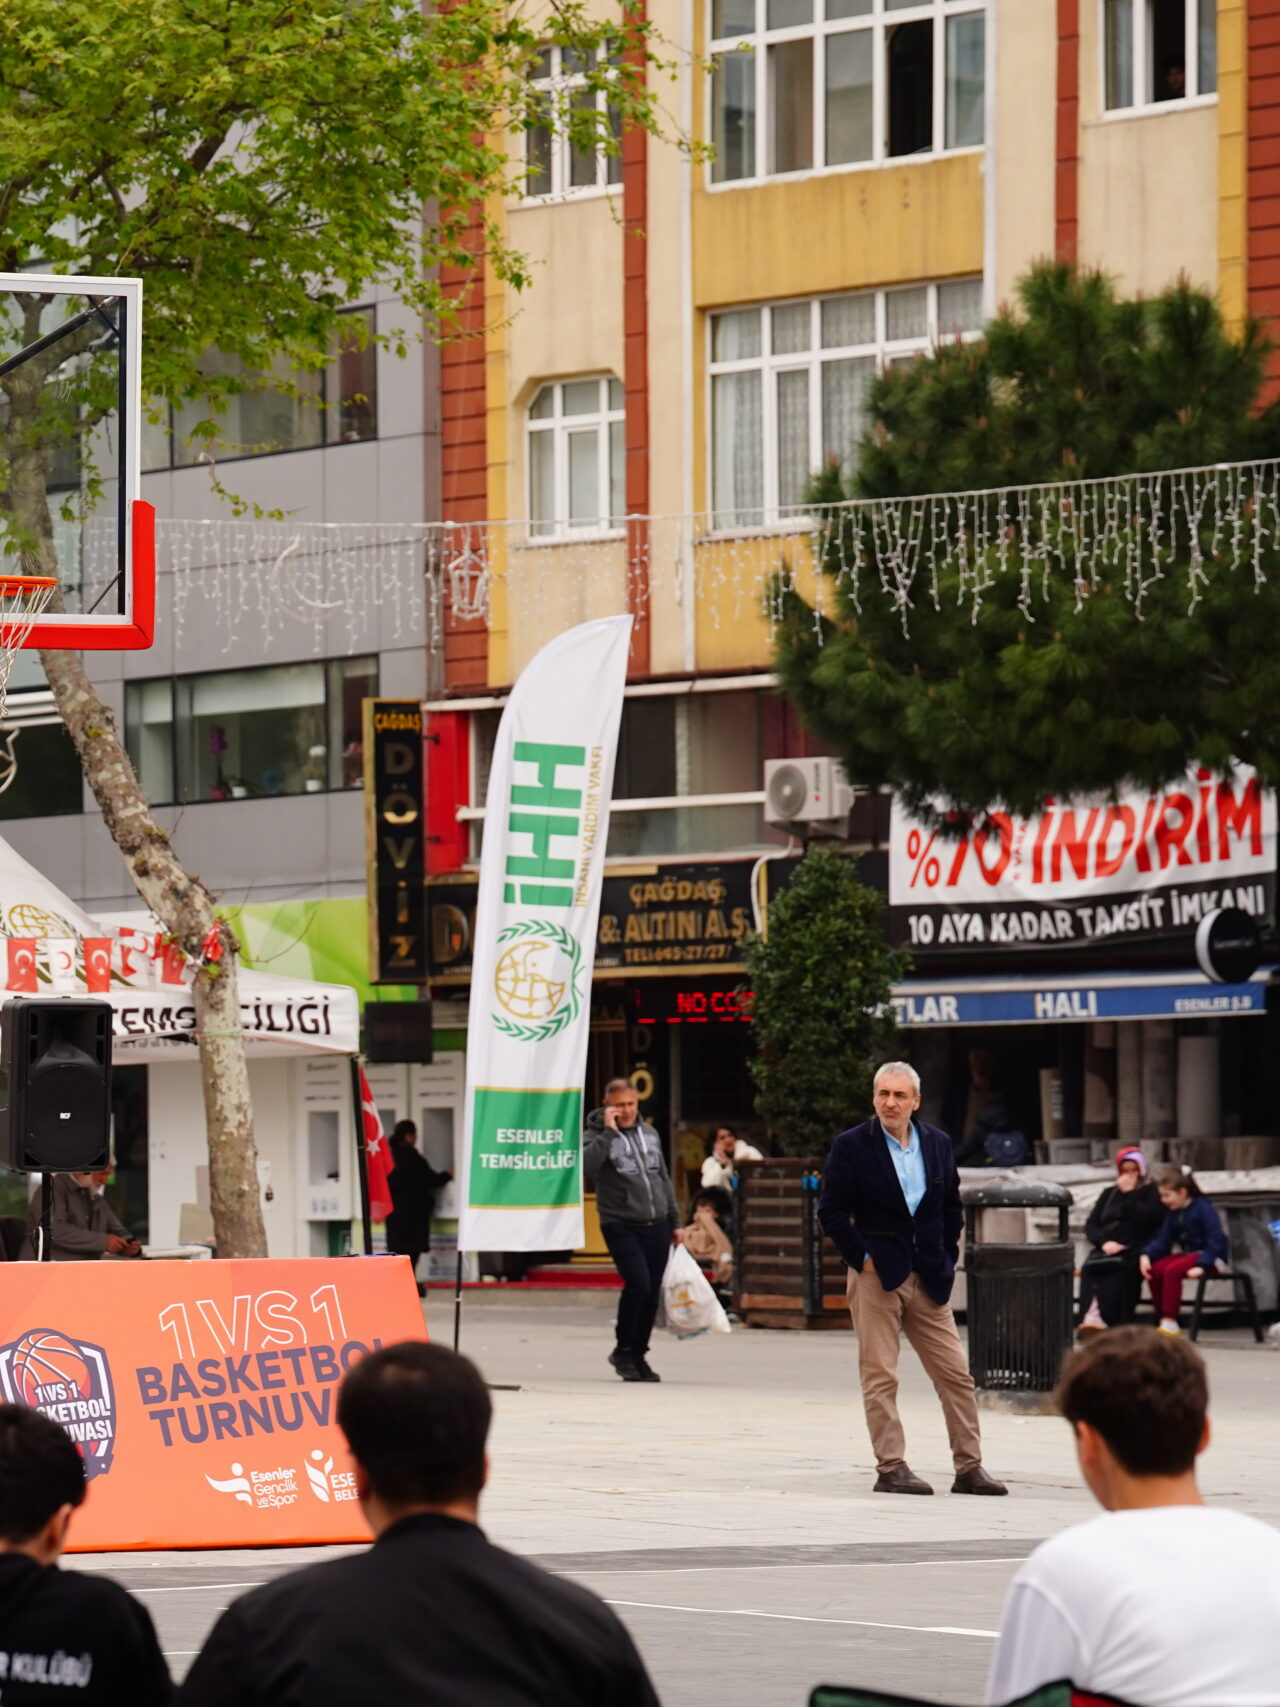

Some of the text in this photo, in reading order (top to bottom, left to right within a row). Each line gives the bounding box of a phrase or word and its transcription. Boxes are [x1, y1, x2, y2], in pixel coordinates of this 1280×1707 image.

[373, 710, 421, 732] ÇAĞDAŞ
[587, 745, 604, 791] VAKFI
[581, 794, 600, 854] YARDIM
[629, 877, 726, 908] ÇAĞDAŞ
[598, 914, 619, 944] &
[623, 909, 703, 943] ALTIN
[907, 913, 935, 945] 10
[938, 912, 985, 944] AYA
[989, 909, 1075, 943] KADAR
[1034, 991, 1099, 1020] HALI
[496, 1128, 564, 1145] ESENLER
[479, 1149, 577, 1170] TEMSİLCİLİĞİ
[195, 1289, 308, 1355] VS
[148, 1388, 332, 1448] TURNUV
[249, 1466, 297, 1484] Esenler
[252, 1480, 299, 1497] Gençlik
[256, 1493, 298, 1509] ve Spor
